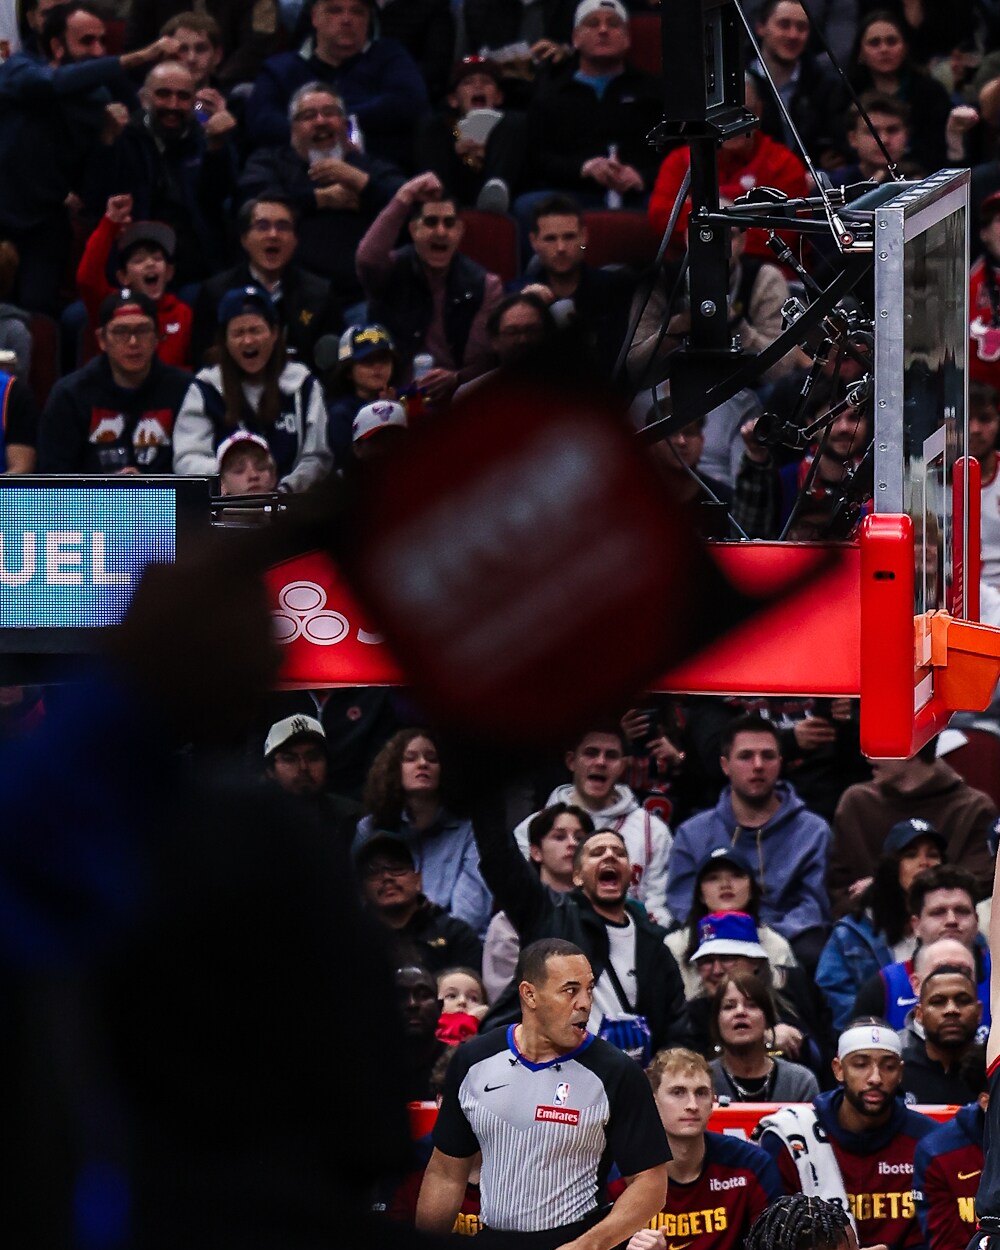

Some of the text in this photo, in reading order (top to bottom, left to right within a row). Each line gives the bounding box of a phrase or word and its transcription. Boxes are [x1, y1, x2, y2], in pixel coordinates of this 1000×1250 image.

[0, 531, 132, 585] UEL
[536, 1108, 578, 1122] Emirates
[709, 1176, 746, 1191] ibotta
